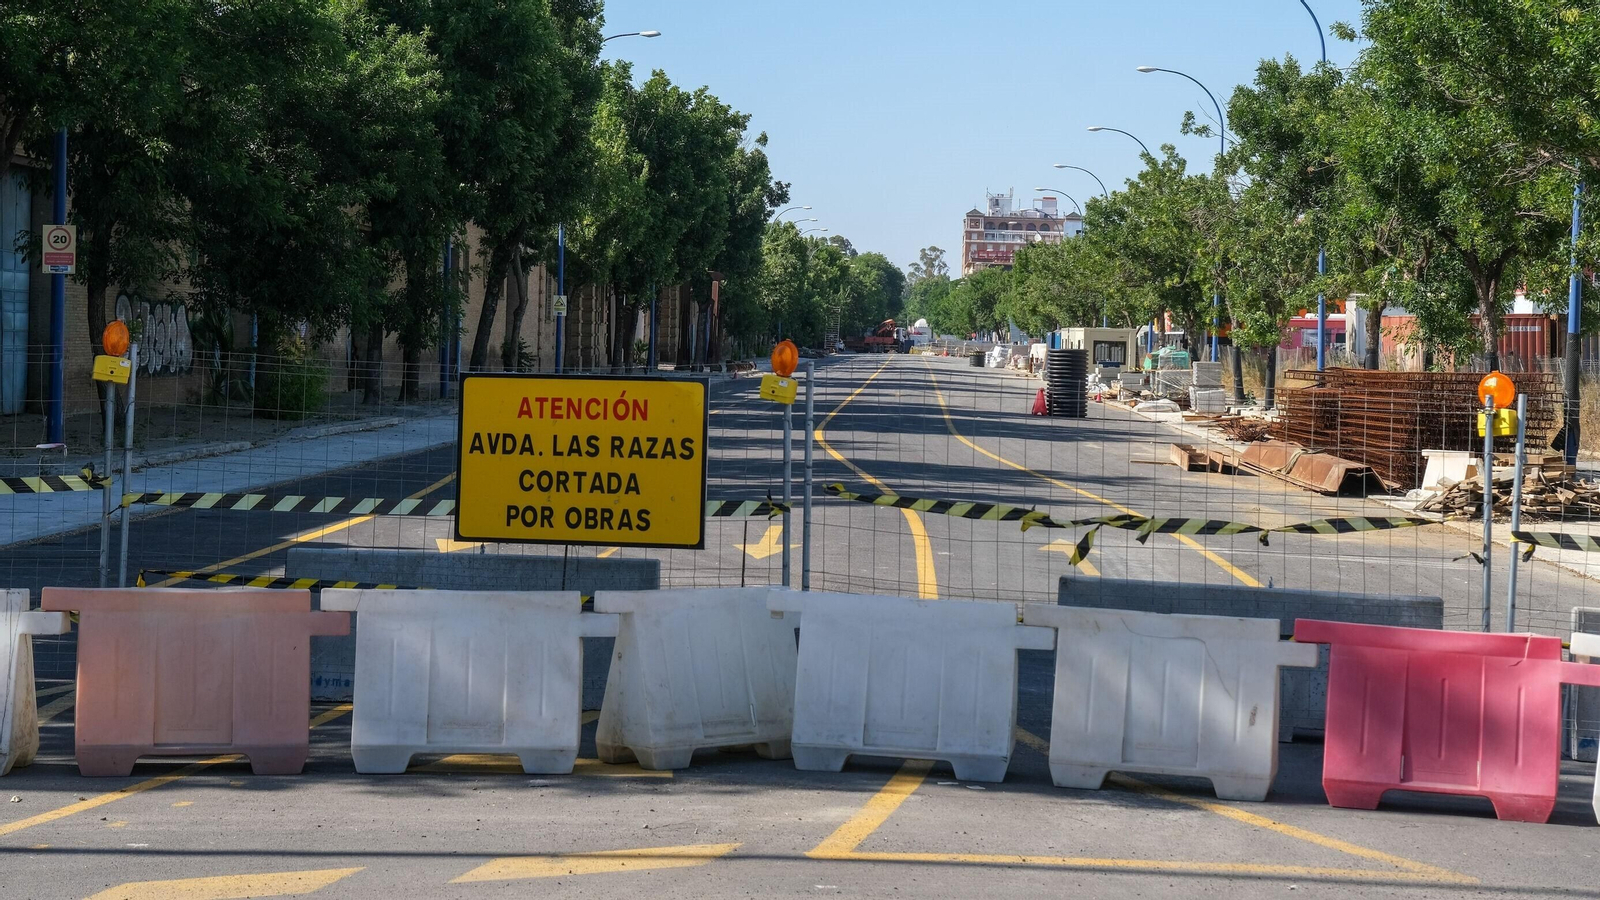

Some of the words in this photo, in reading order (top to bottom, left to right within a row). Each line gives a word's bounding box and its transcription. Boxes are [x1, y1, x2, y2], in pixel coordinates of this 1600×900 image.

[53, 235, 67, 244] 20
[517, 390, 648, 421] ATENCIÓN
[469, 432, 543, 456] AVDA.
[552, 434, 600, 458] LAS
[610, 436, 695, 460] RAZAS
[519, 469, 641, 495] CORTADA
[506, 505, 554, 529] POR
[565, 507, 651, 532] OBRAS
